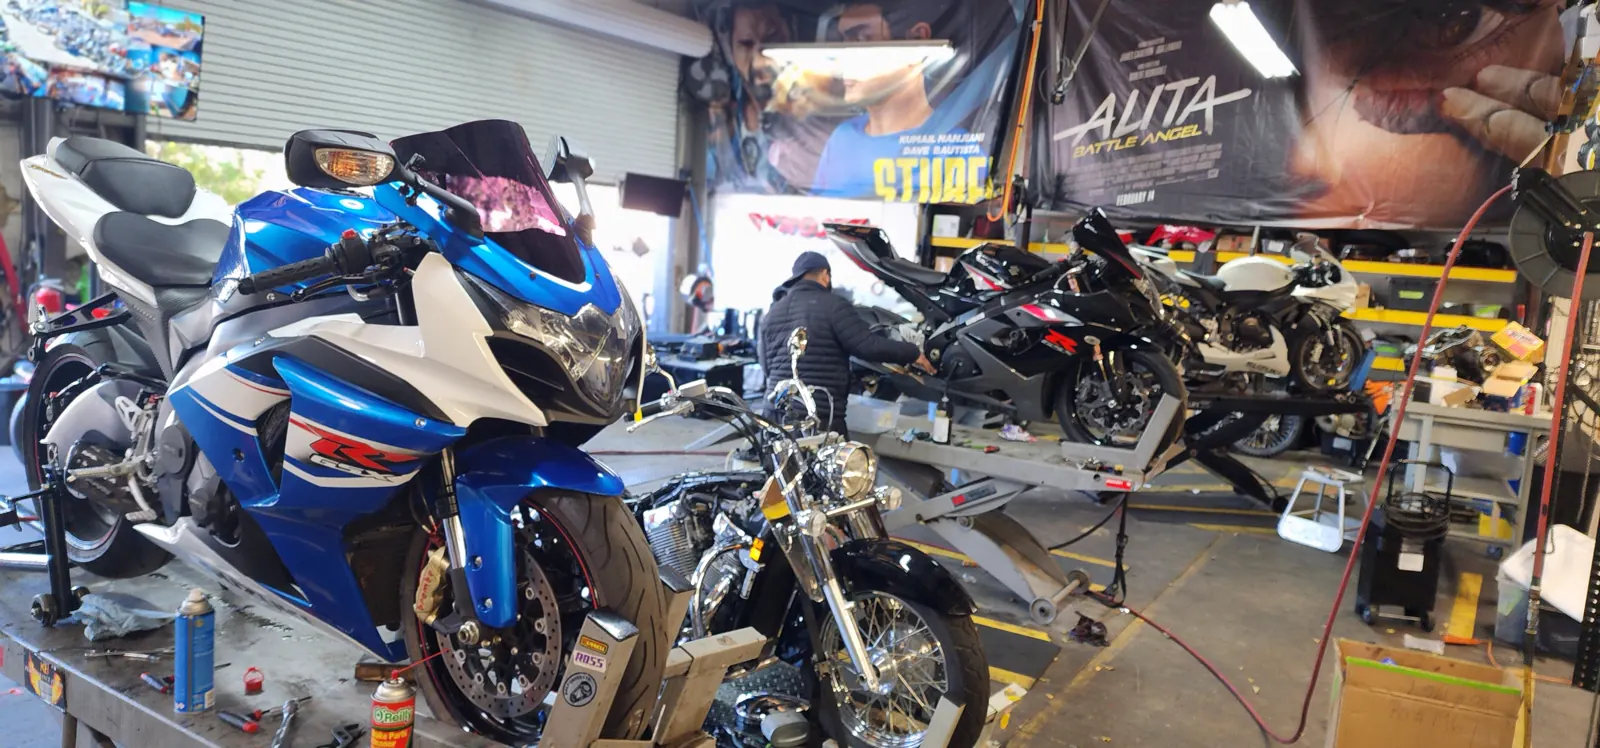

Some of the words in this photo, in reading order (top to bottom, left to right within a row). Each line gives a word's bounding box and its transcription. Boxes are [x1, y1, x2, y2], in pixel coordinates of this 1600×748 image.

[1053, 75, 1252, 146] ALITA
[1072, 136, 1137, 159] BATTLE
[1141, 124, 1203, 146] ANGEL
[873, 156, 995, 205] STUBE
